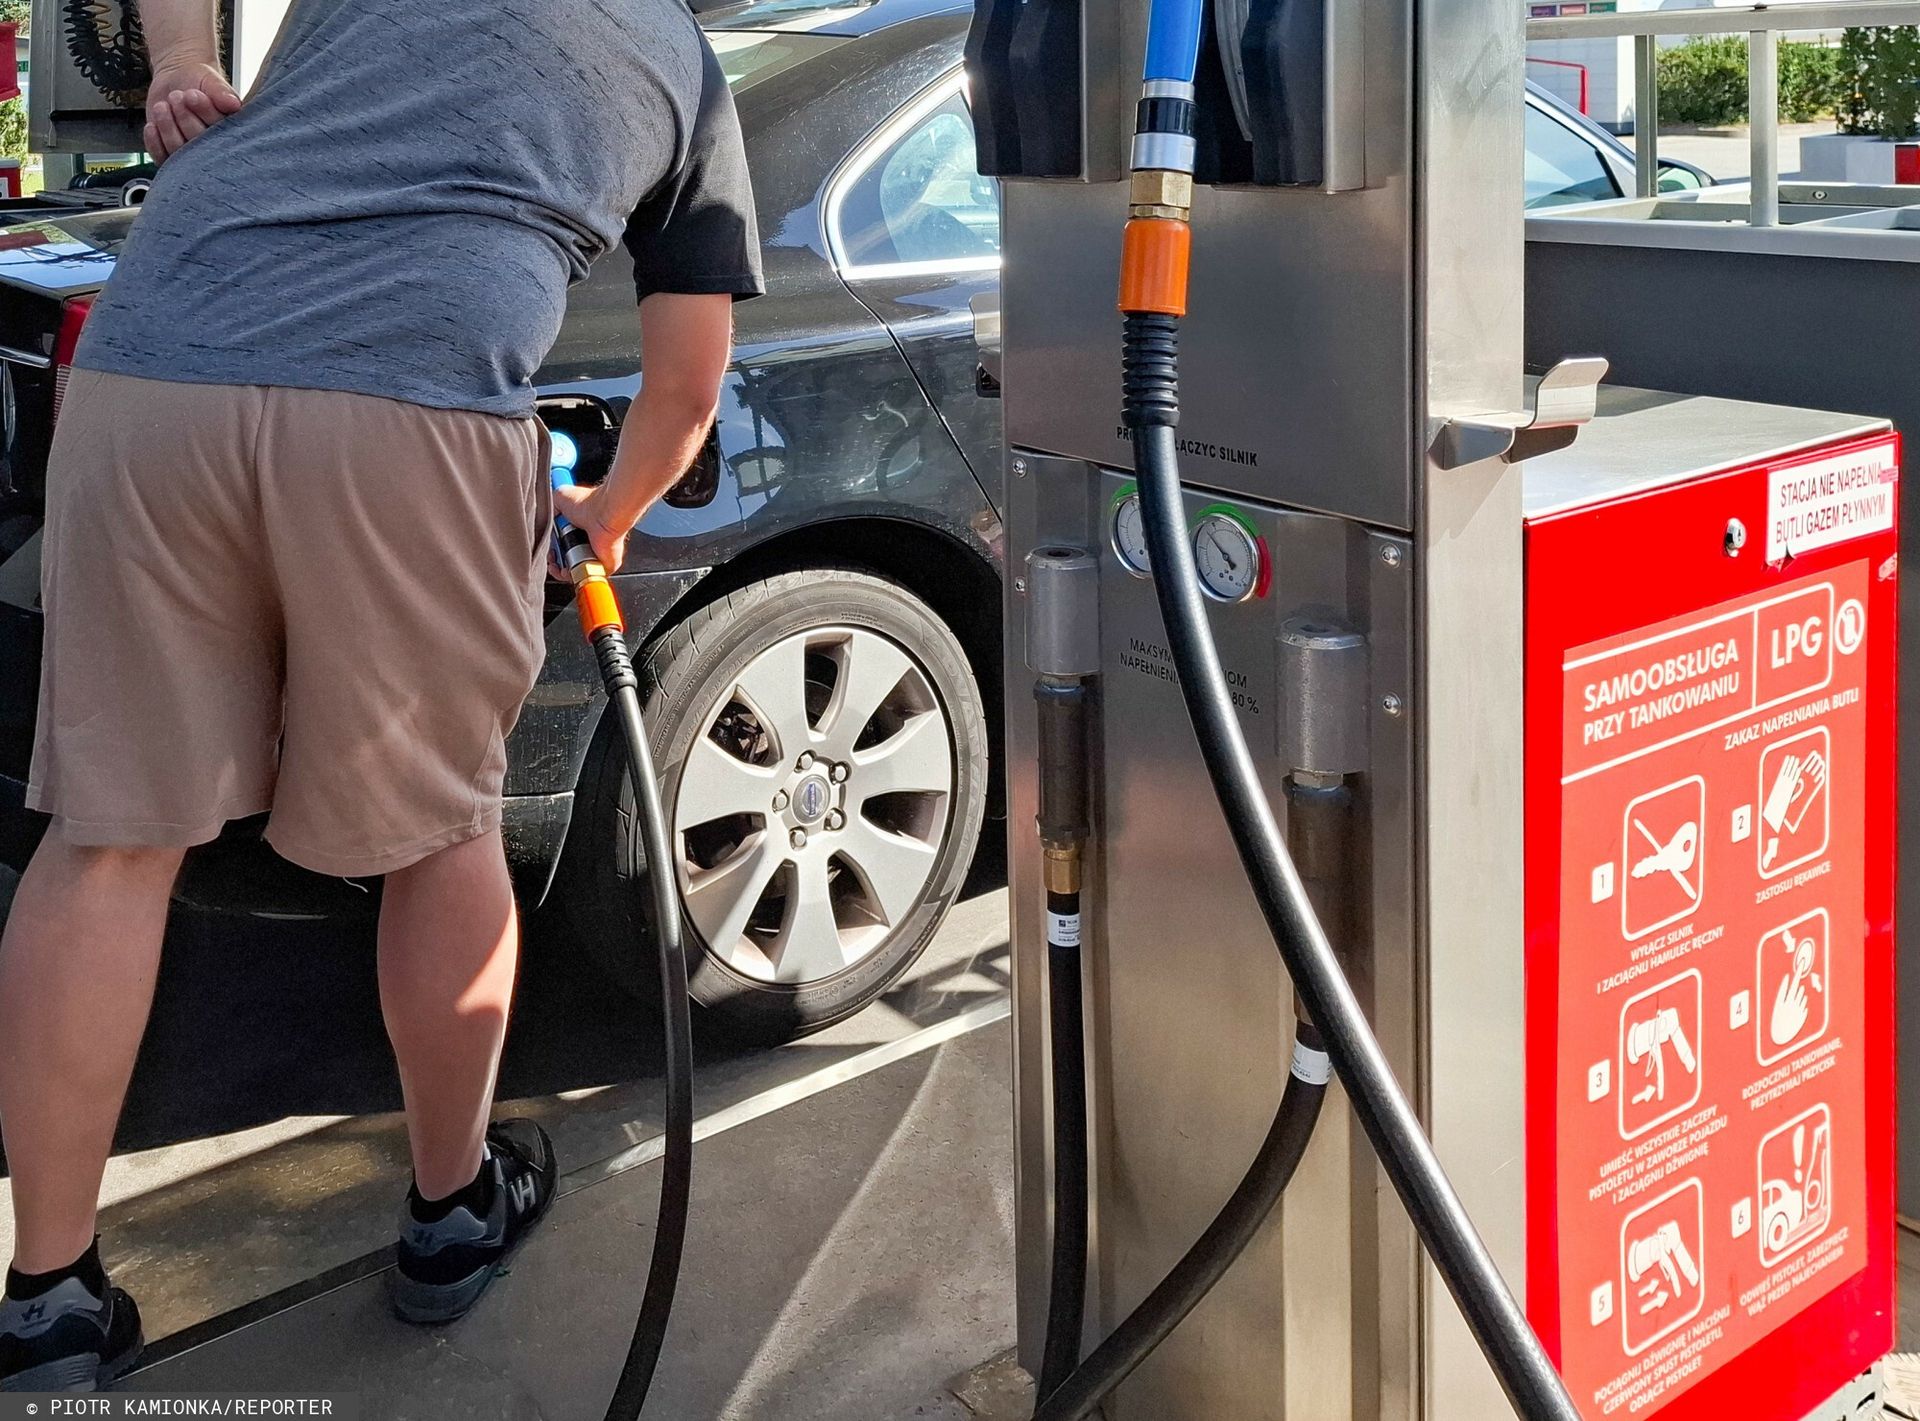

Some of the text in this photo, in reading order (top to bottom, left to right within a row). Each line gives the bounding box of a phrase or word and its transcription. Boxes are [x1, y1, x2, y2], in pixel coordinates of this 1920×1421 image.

[1219, 446, 1258, 467] SILNIK
[1781, 477, 1817, 508] STACJA
[1820, 472, 1835, 497] NIE
[1776, 493, 1886, 544] BUTLI GAZEM PŁYNNYM
[1771, 616, 1823, 669] LPG
[1120, 652, 1179, 684] NAPEŁNIENI
[1231, 692, 1245, 708] 80
[1584, 638, 1739, 712] SAMOOBSŁUGA
[1584, 672, 1740, 746] PRZY TANKOWANIU
[1724, 687, 1859, 751] ZAKAZ NAPEŁNIANIA BUTLI
[1738, 815, 1744, 830] 2
[1600, 874, 1605, 889] 1
[1755, 860, 1832, 905] ZASTOSUJ RĘKAWICE
[1596, 924, 1725, 995] I ZACIĄGNIJ HAMULEC RĘCZNY
[1630, 923, 1694, 962] WYŁĄCZ SILNIK
[1736, 1001, 1742, 1015] 4
[1596, 1072, 1602, 1088] 3
[1742, 1064, 1791, 1100] ROZPOCZNIJ
[1802, 1054, 1836, 1082] PRZYCISK
[1589, 1115, 1728, 1202] PISTOLETU W ZAWORZE POJAZDU
[1600, 1104, 1718, 1178] UMIEŚĆ WSZYSTKIE ZACZEPY
[1617, 1167, 1664, 1203] ZACIĄGNIJ
[1738, 1209, 1744, 1225] 6
[1806, 1226, 1849, 1263] ZABEZPIECZ
[1767, 1281, 1792, 1304] PRZED
[1791, 1245, 1845, 1288] NAJECHANIEM
[1599, 1295, 1605, 1312] 5
[1594, 1363, 1642, 1404] POCIĄGNIJ
[1692, 1304, 1731, 1338] NACIŚNIJ
[1603, 1374, 1653, 1416] CZERWONY
[1653, 1355, 1679, 1381] SPUST
[1629, 1355, 1702, 1413] ODŁĄCZ PISTOLET
